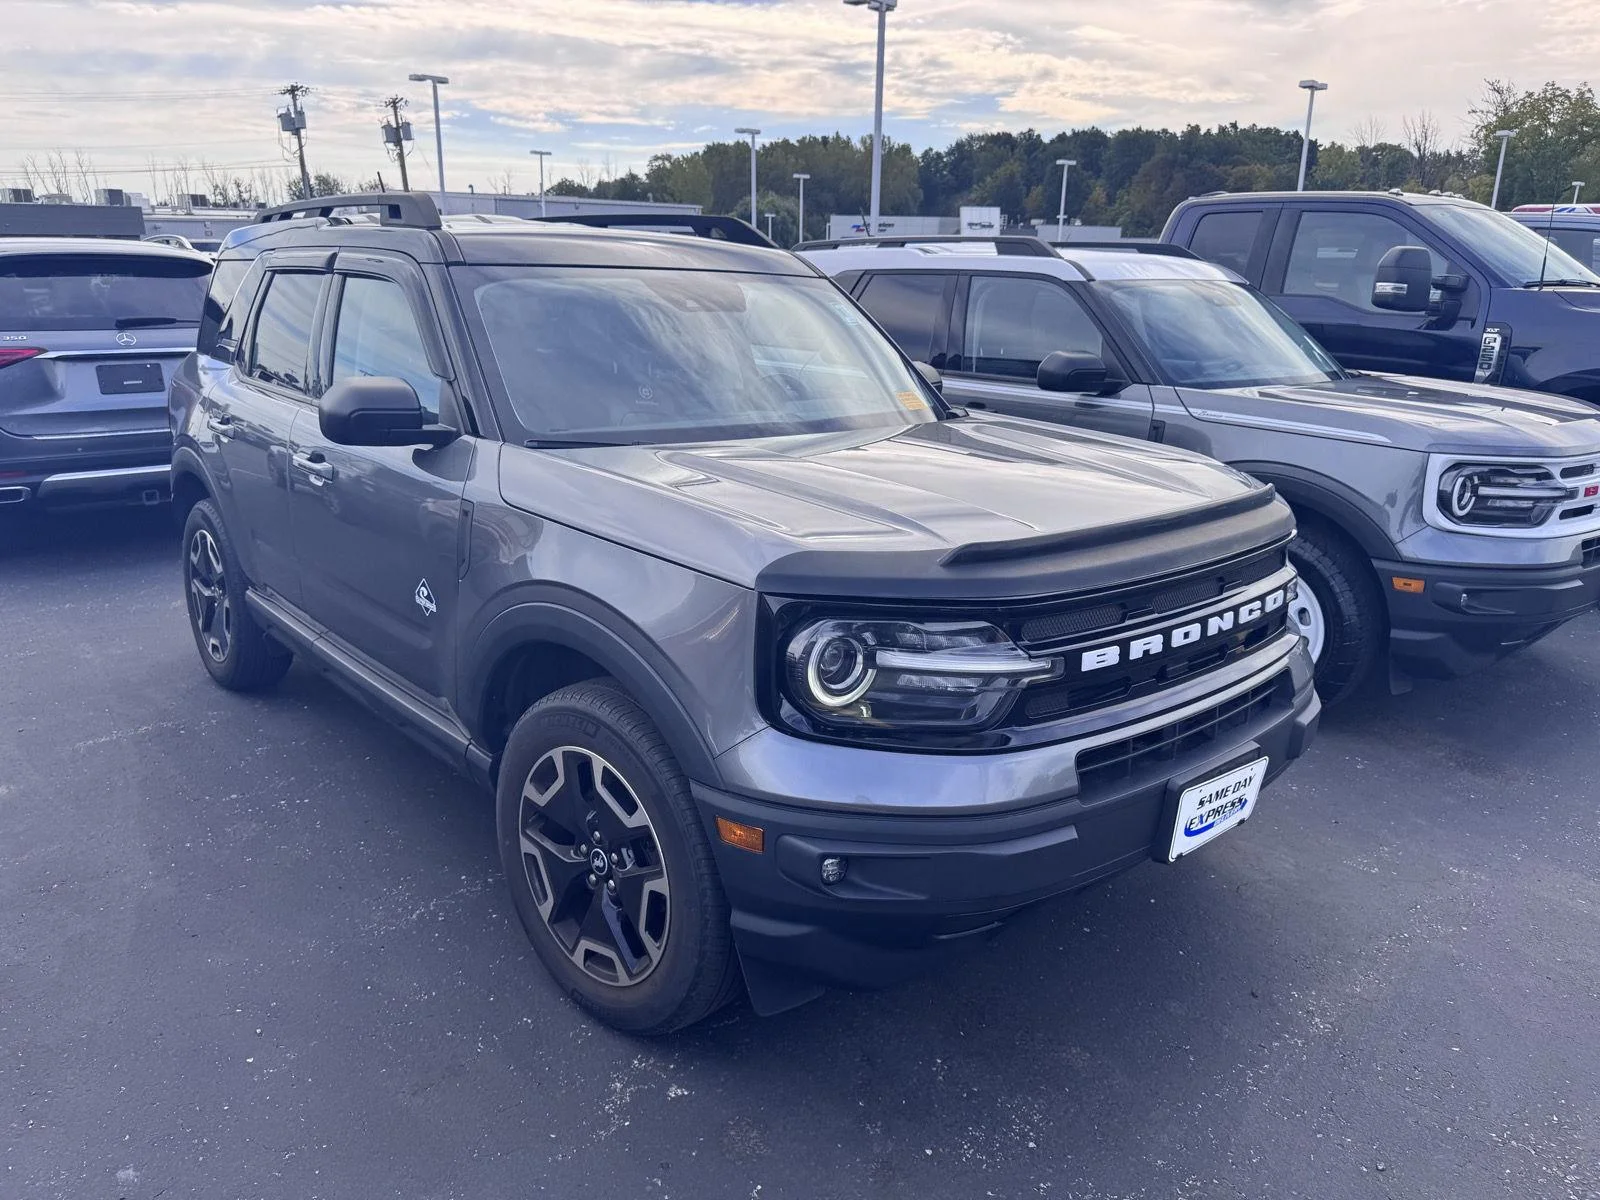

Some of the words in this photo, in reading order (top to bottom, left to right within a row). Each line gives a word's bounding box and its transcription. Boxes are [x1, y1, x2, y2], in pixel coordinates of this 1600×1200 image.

[1080, 589, 1285, 672] BRONCO
[1197, 785, 1233, 810] SAME
[1231, 773, 1256, 795] DAY
[1188, 793, 1246, 831] EXPRESS
